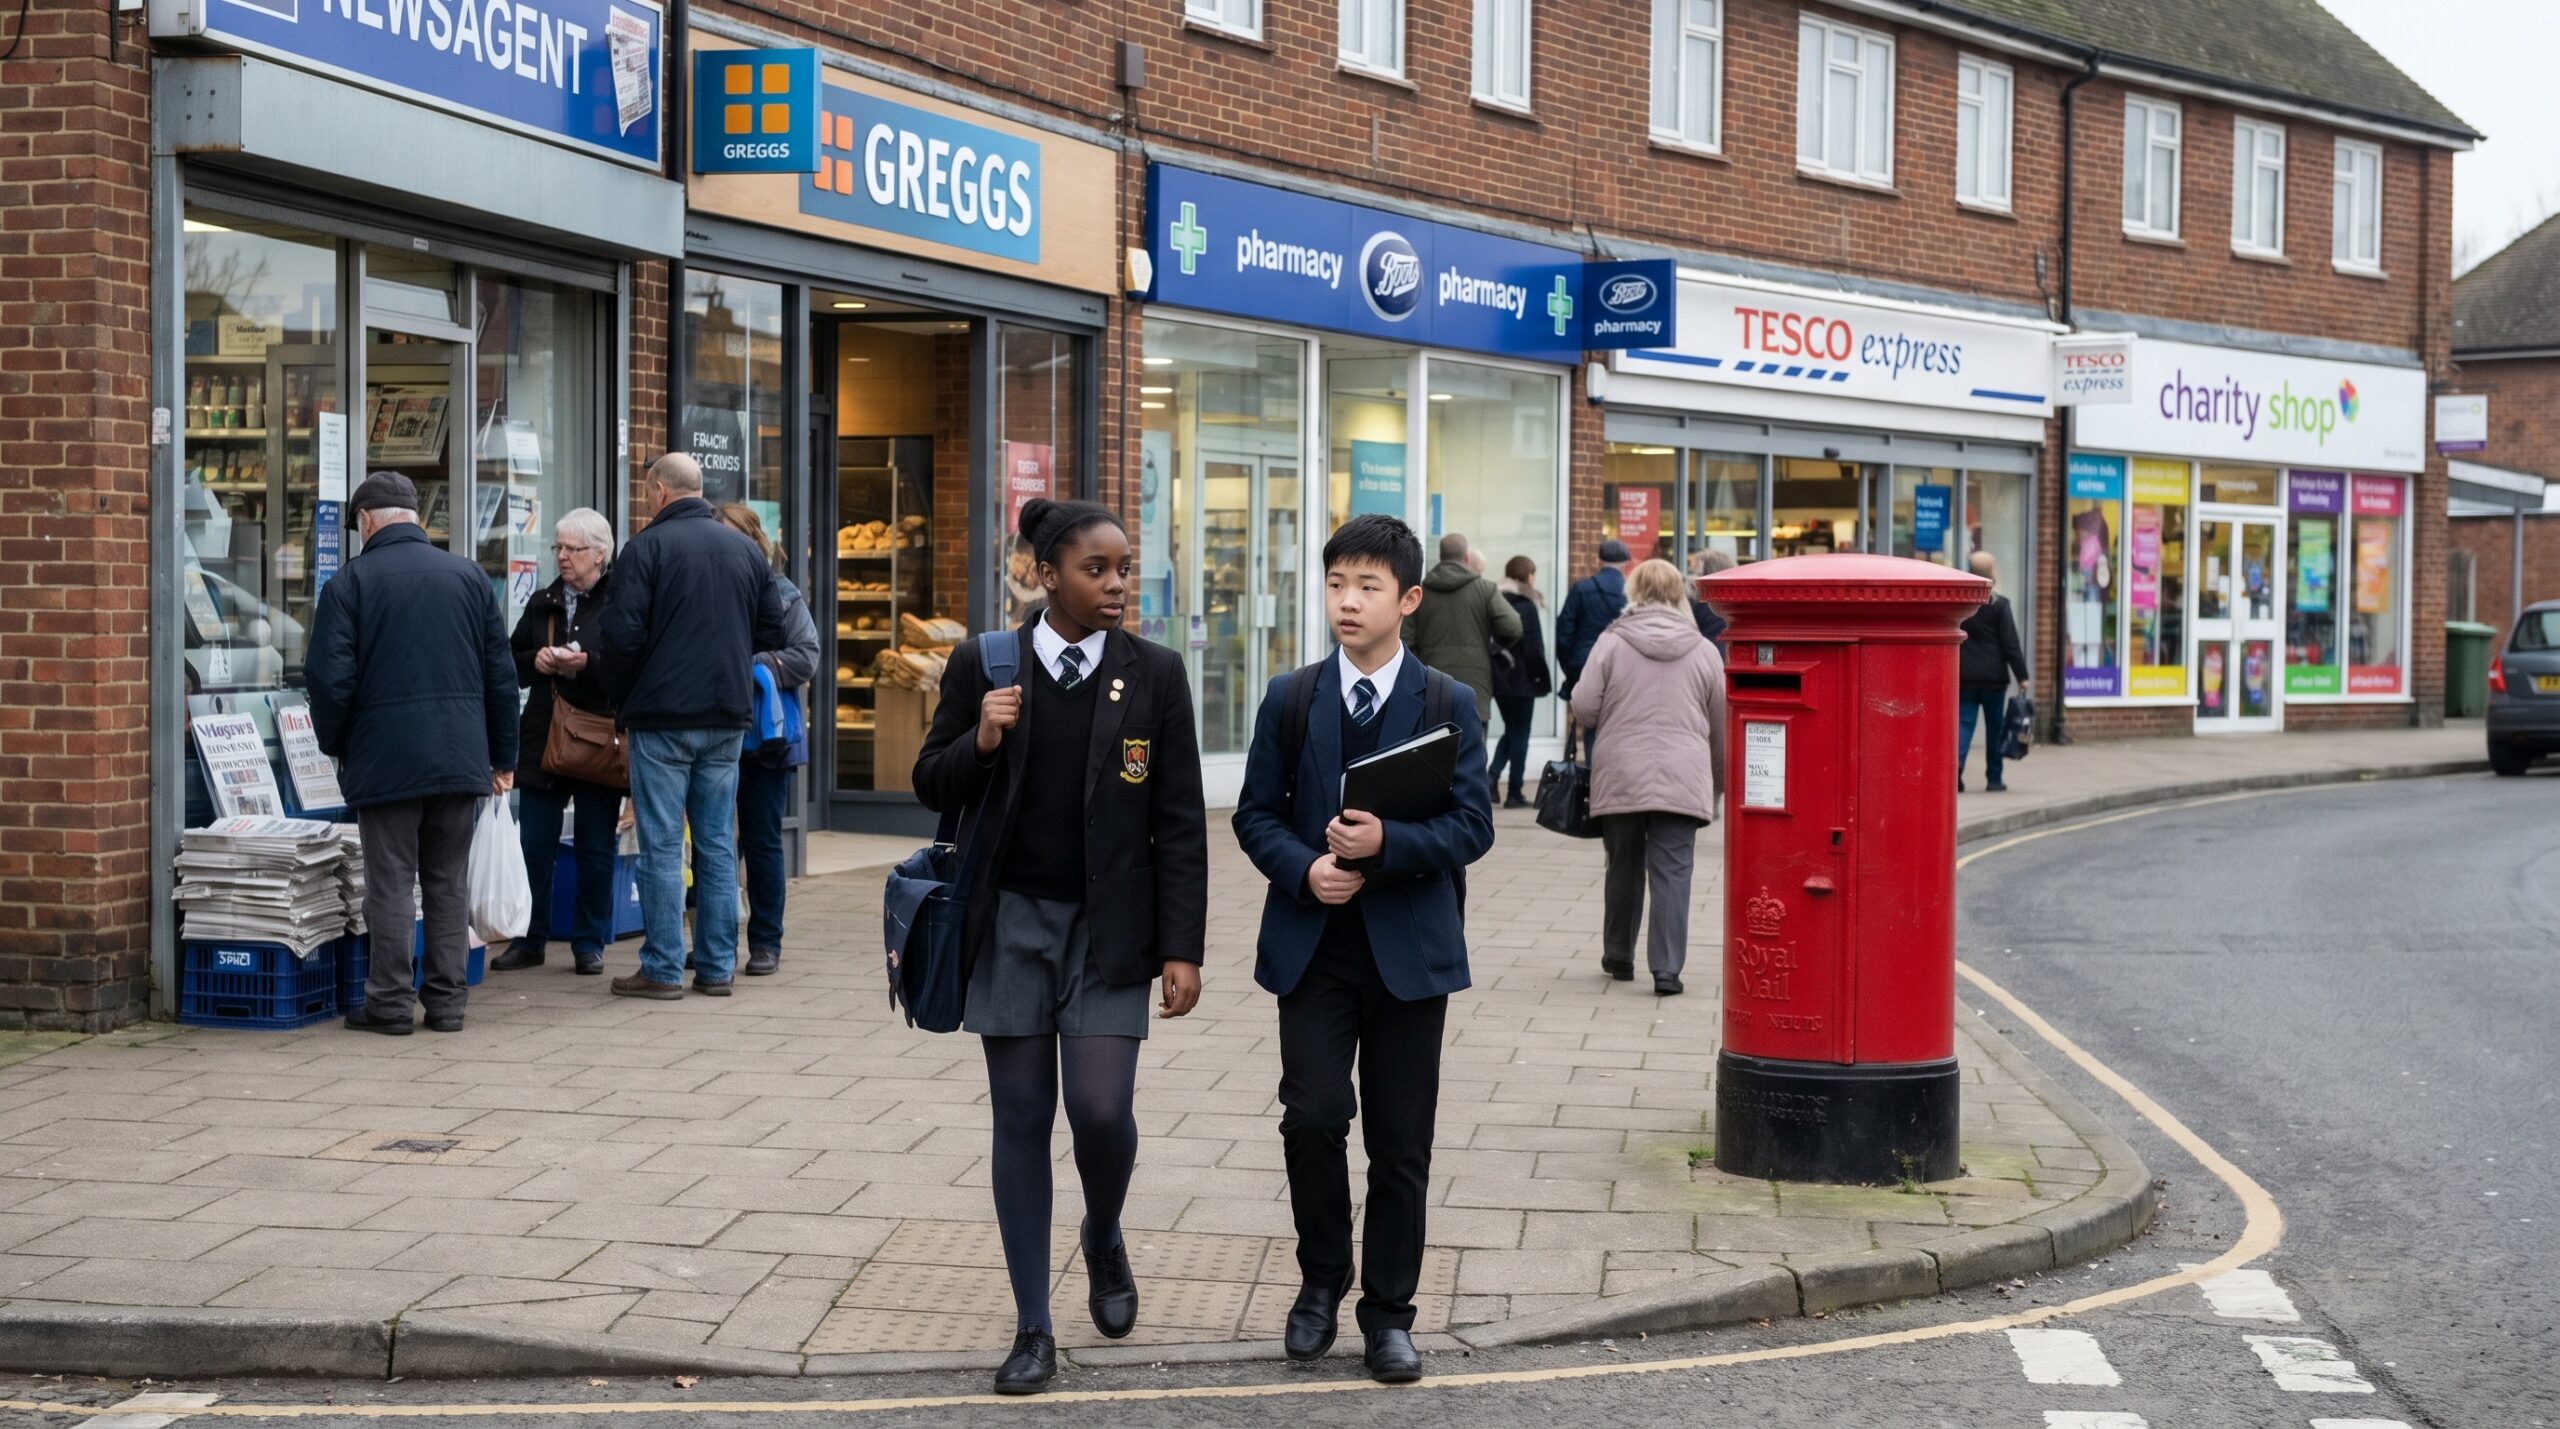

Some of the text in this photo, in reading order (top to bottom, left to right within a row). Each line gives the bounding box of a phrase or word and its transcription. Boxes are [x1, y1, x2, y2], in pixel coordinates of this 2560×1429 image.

[723, 143, 790, 159] GREGGS
[864, 123, 1032, 237] GREGGS
[1237, 228, 1527, 320] pharmacy Boots pharmacy
[1594, 319, 1662, 336] pharmacy
[1734, 306, 1962, 380] TESCO express
[2064, 353, 2125, 368] TESCO
[2063, 377, 2124, 394] express
[2160, 369, 2335, 448] charity shop
[1734, 937, 1798, 975] Royal
[1739, 969, 1791, 1000] Mail
